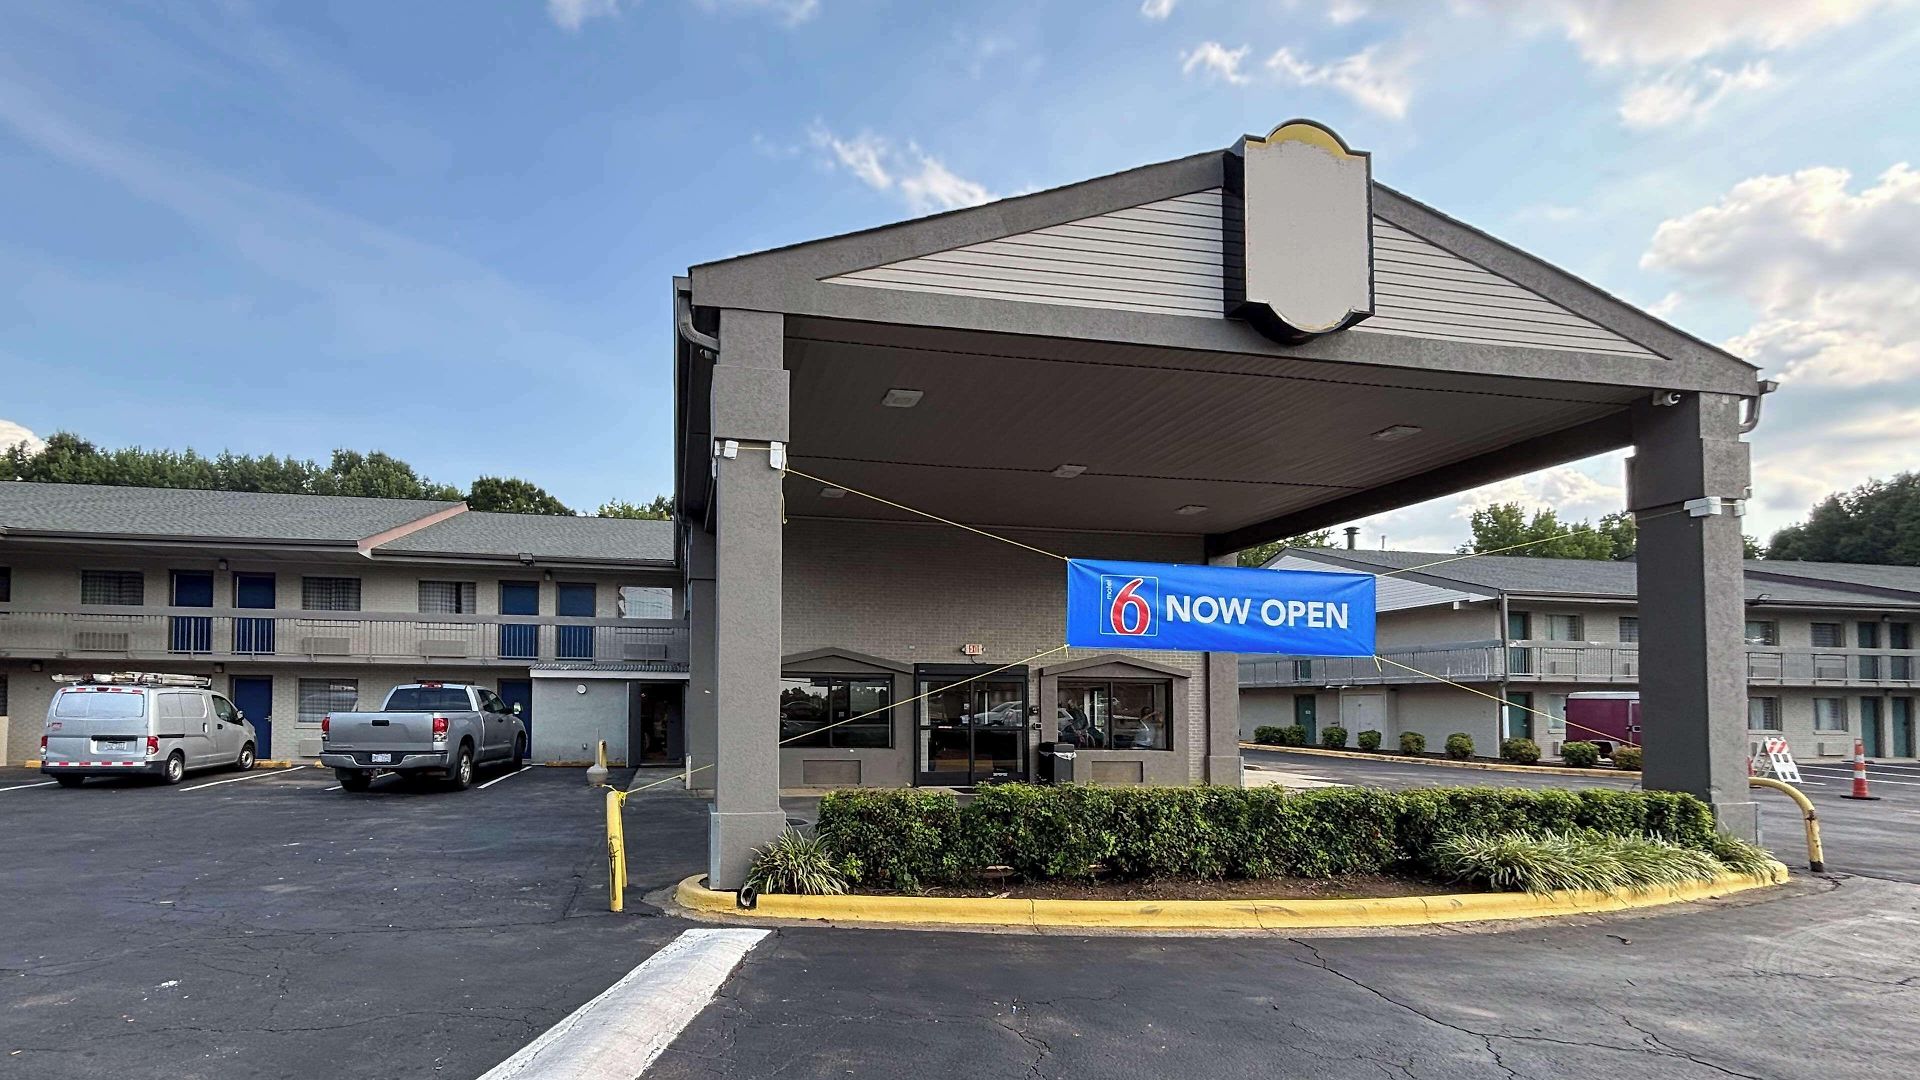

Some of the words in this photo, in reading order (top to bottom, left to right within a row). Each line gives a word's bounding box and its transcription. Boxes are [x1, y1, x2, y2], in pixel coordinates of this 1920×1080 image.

[1111, 578, 1151, 635] 6
[1166, 595, 1251, 625] NOW
[1260, 599, 1348, 629] OPEN
